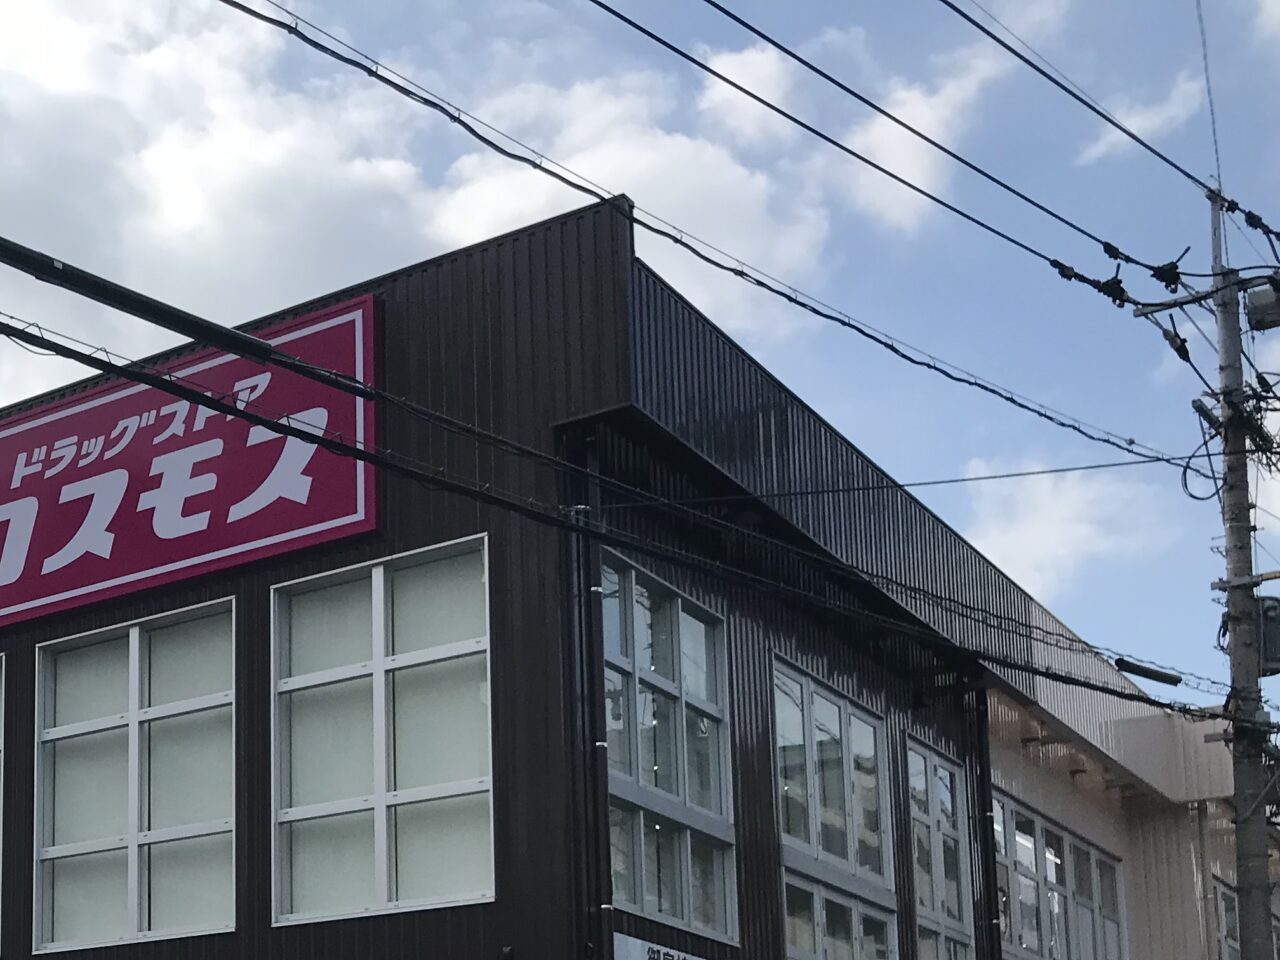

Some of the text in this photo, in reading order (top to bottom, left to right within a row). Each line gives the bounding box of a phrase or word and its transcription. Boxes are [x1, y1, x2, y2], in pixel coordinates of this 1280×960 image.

[10, 372, 273, 490] ドラッグストア
